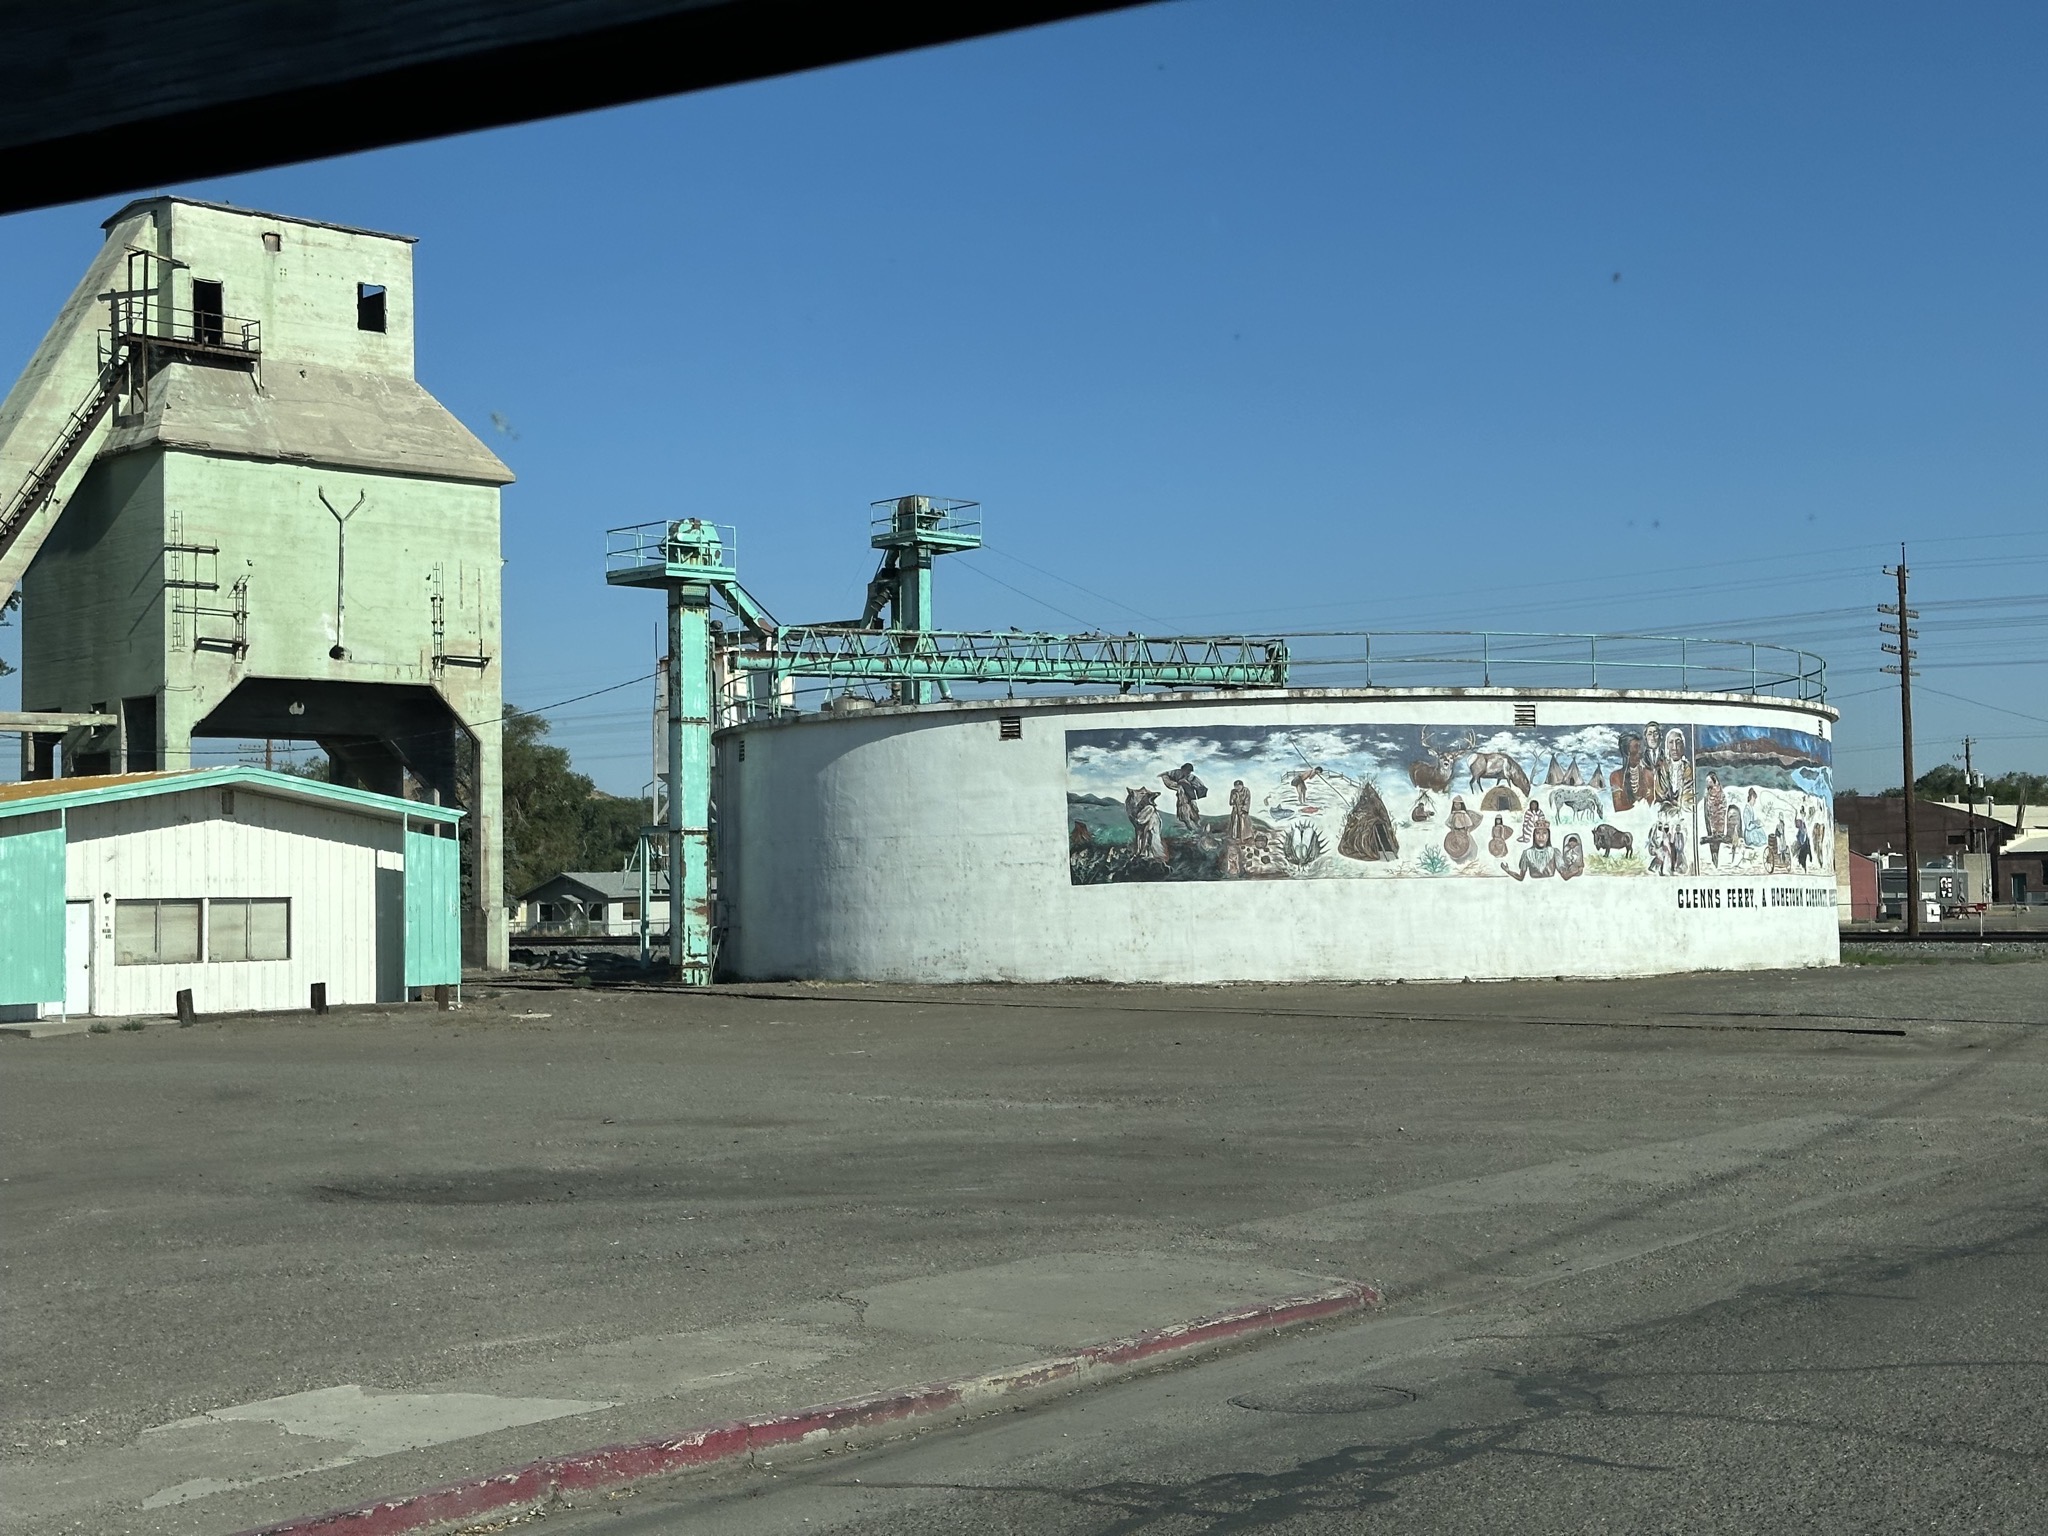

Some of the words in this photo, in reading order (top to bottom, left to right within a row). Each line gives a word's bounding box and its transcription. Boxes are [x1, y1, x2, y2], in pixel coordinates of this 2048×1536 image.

[1677, 888, 1721, 909] GLENNS
[1727, 887, 1758, 911] FERRY,
[1761, 887, 1767, 908] A
